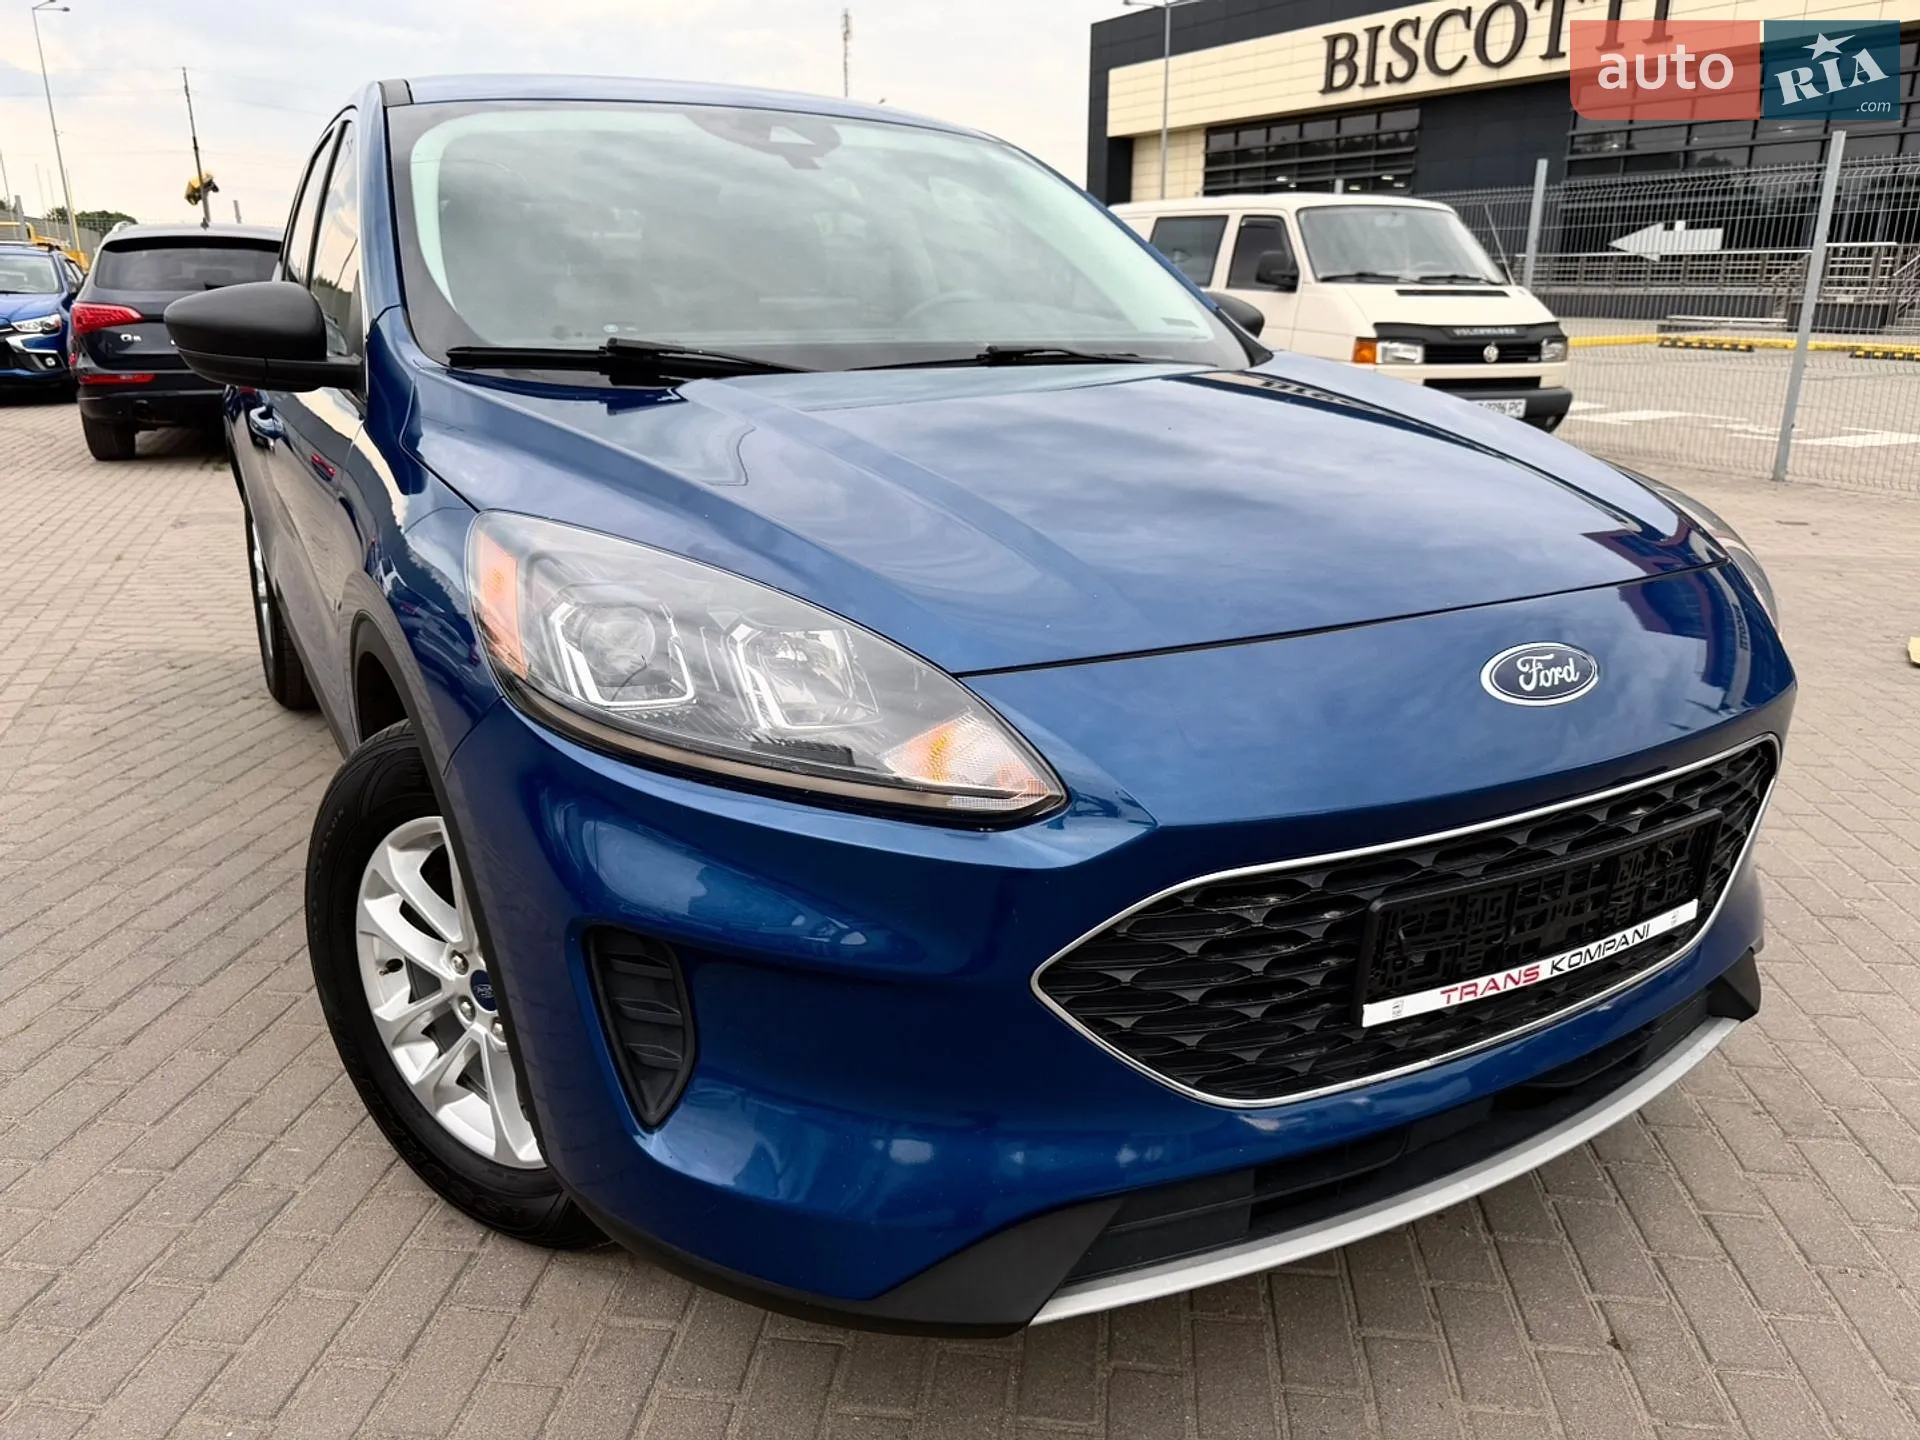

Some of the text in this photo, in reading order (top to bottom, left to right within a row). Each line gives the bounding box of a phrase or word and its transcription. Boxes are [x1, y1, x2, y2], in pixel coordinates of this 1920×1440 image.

[1516, 653, 1580, 692] Ford
[1440, 924, 1651, 1005] TRANS KOMPANI
